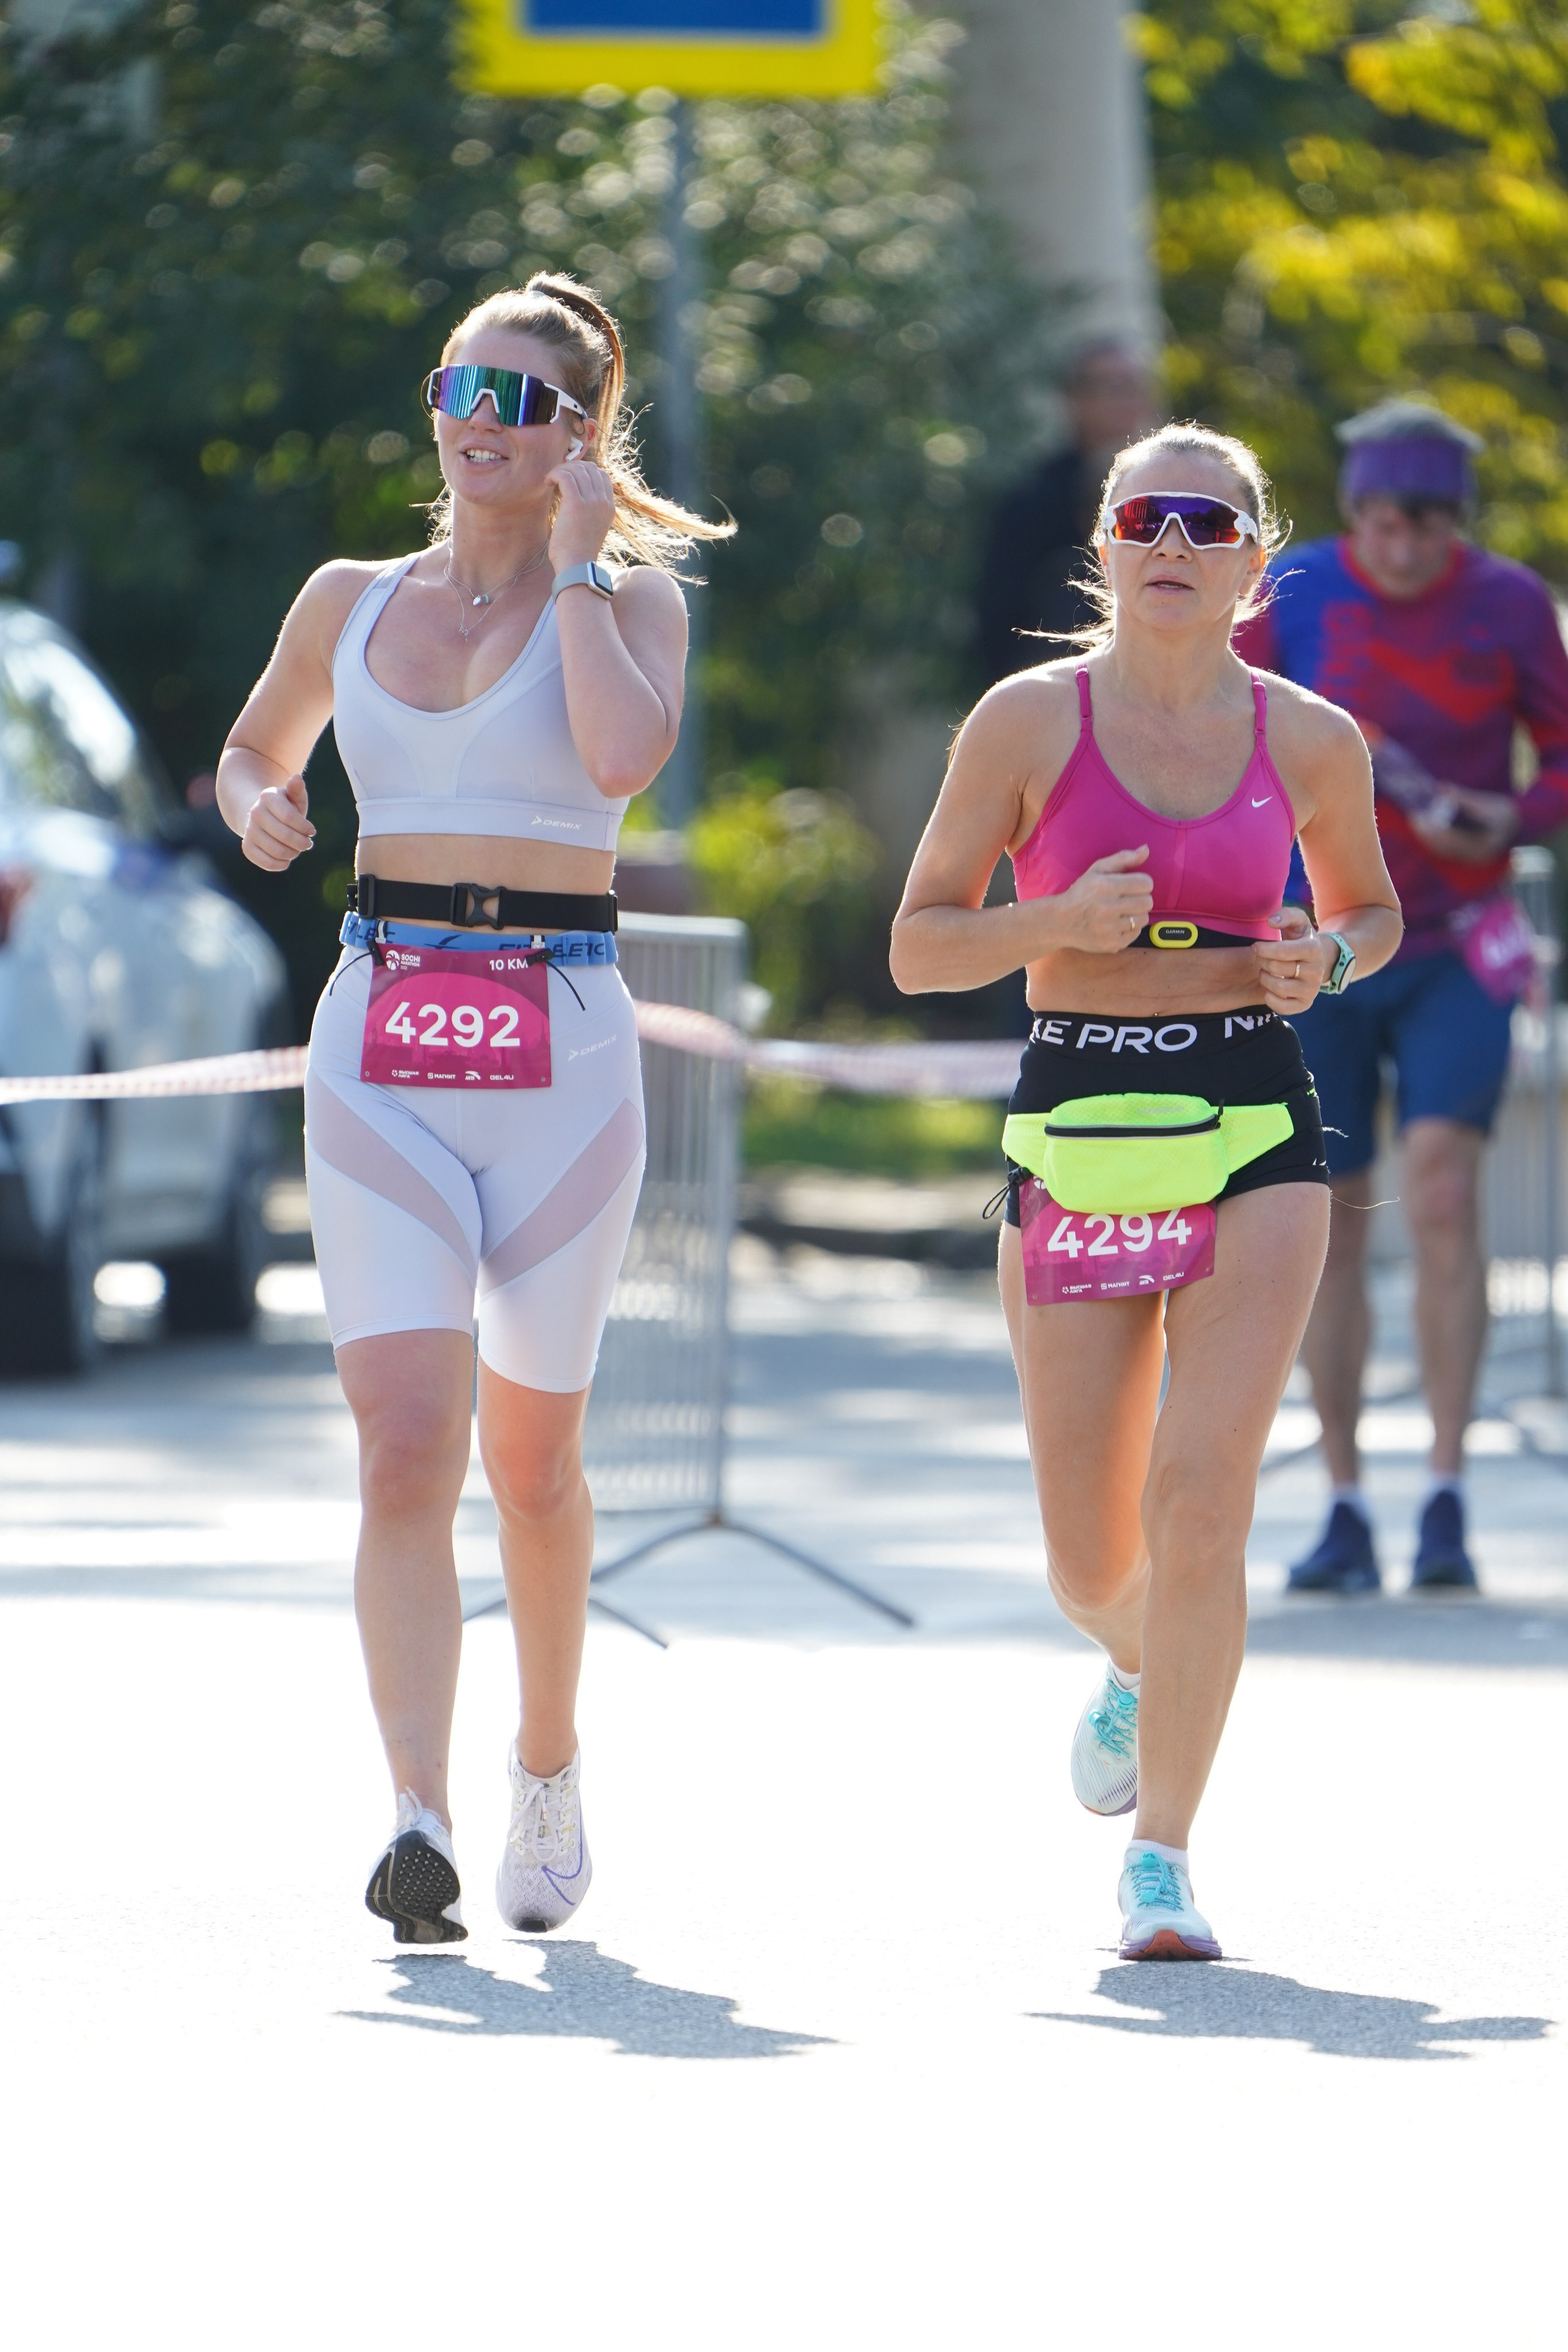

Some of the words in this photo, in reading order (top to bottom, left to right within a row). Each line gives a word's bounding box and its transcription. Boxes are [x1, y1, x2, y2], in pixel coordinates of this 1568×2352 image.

[543, 820, 581, 829] DEMIX
[401, 954, 420, 962] SOCHI
[489, 959, 504, 970] 10
[508, 958, 528, 970] KM
[385, 1001, 520, 1047] 4292
[581, 1034, 617, 1056] DEMIX
[1076, 1023, 1197, 1054] PRO
[1047, 1207, 1192, 1258] 4294
